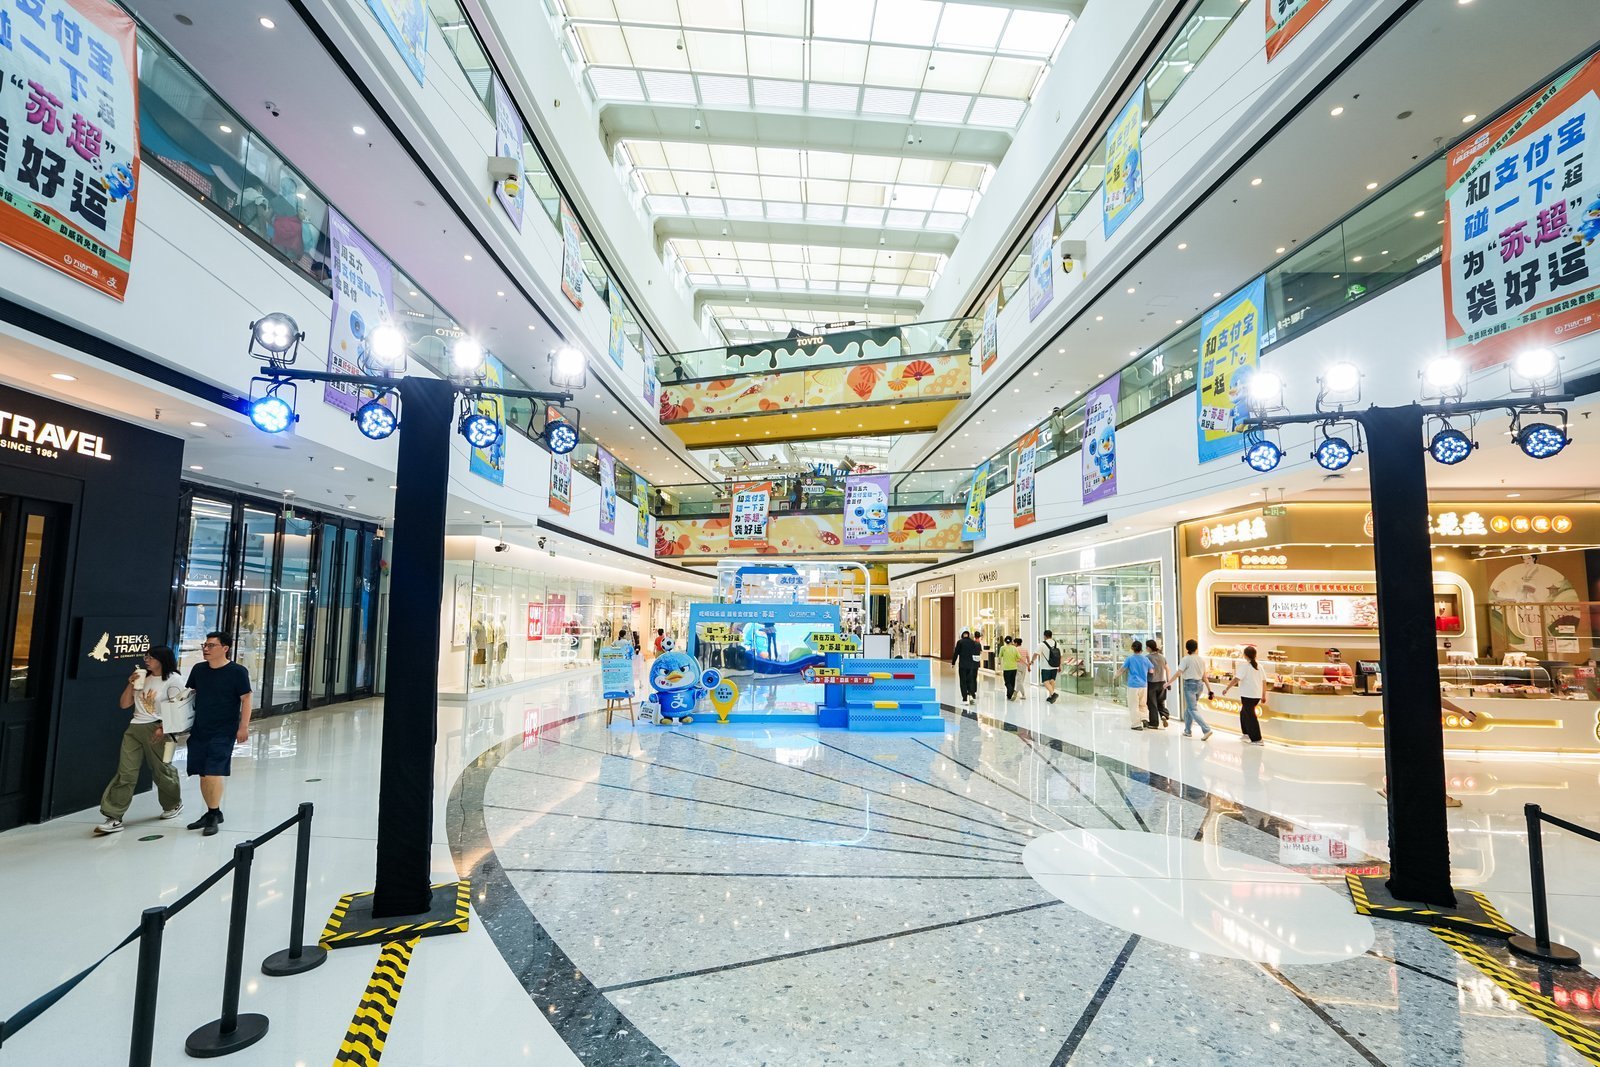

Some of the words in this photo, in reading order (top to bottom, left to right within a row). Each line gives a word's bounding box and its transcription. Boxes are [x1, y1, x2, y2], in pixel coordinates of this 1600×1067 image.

[1466, 113, 1586, 207] 和支付宝
[1562, 153, 1583, 191] 一起
[1465, 168, 1555, 242] 碰一下
[1466, 242, 1590, 324] 袋好运
[797, 336, 824, 346] TOVTO
[1205, 312, 1255, 357] 和支付宝
[1203, 343, 1240, 379] 碰一下
[1202, 373, 1225, 396] 一起
[115, 635, 143, 644] TREK
